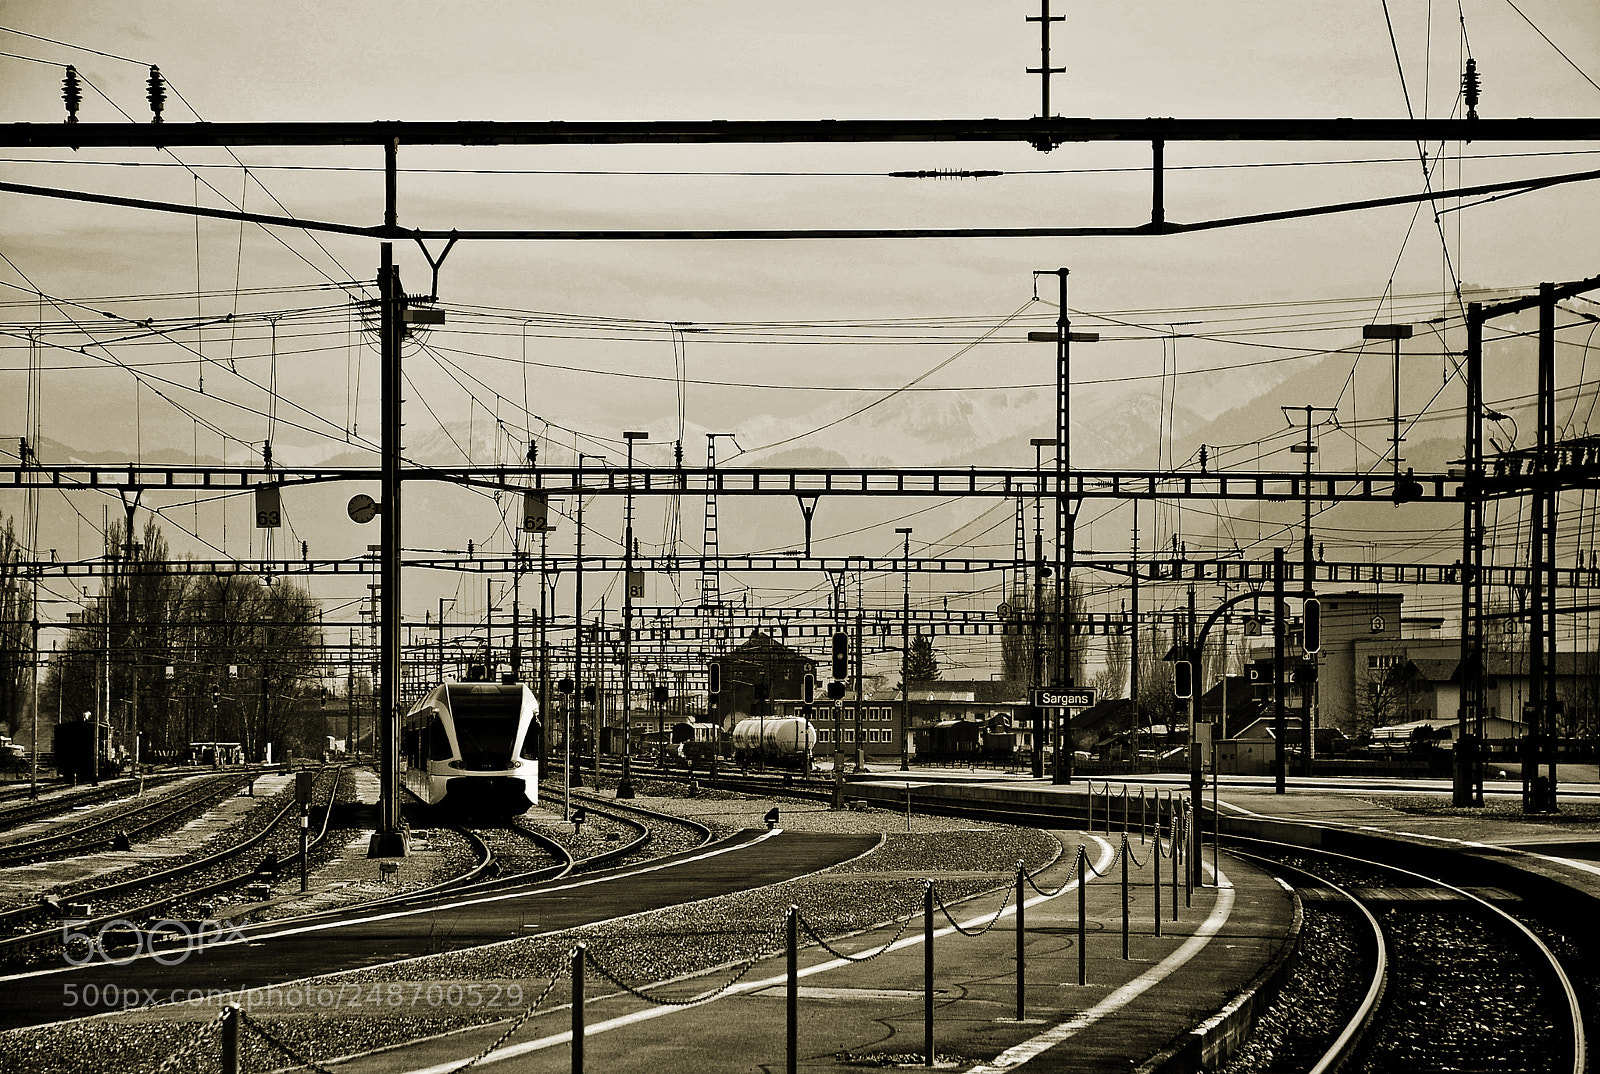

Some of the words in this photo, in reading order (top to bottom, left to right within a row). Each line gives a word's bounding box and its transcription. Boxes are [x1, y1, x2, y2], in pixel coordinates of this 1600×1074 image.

[257, 510, 280, 526] 63
[525, 515, 547, 531] 62
[630, 585, 643, 597] 81
[1001, 605, 1008, 617] 3
[1249, 622, 1257, 634] 2
[1374, 618, 1382, 629] 3
[1250, 670, 1259, 680] D
[1042, 692, 1089, 706] Sargans
